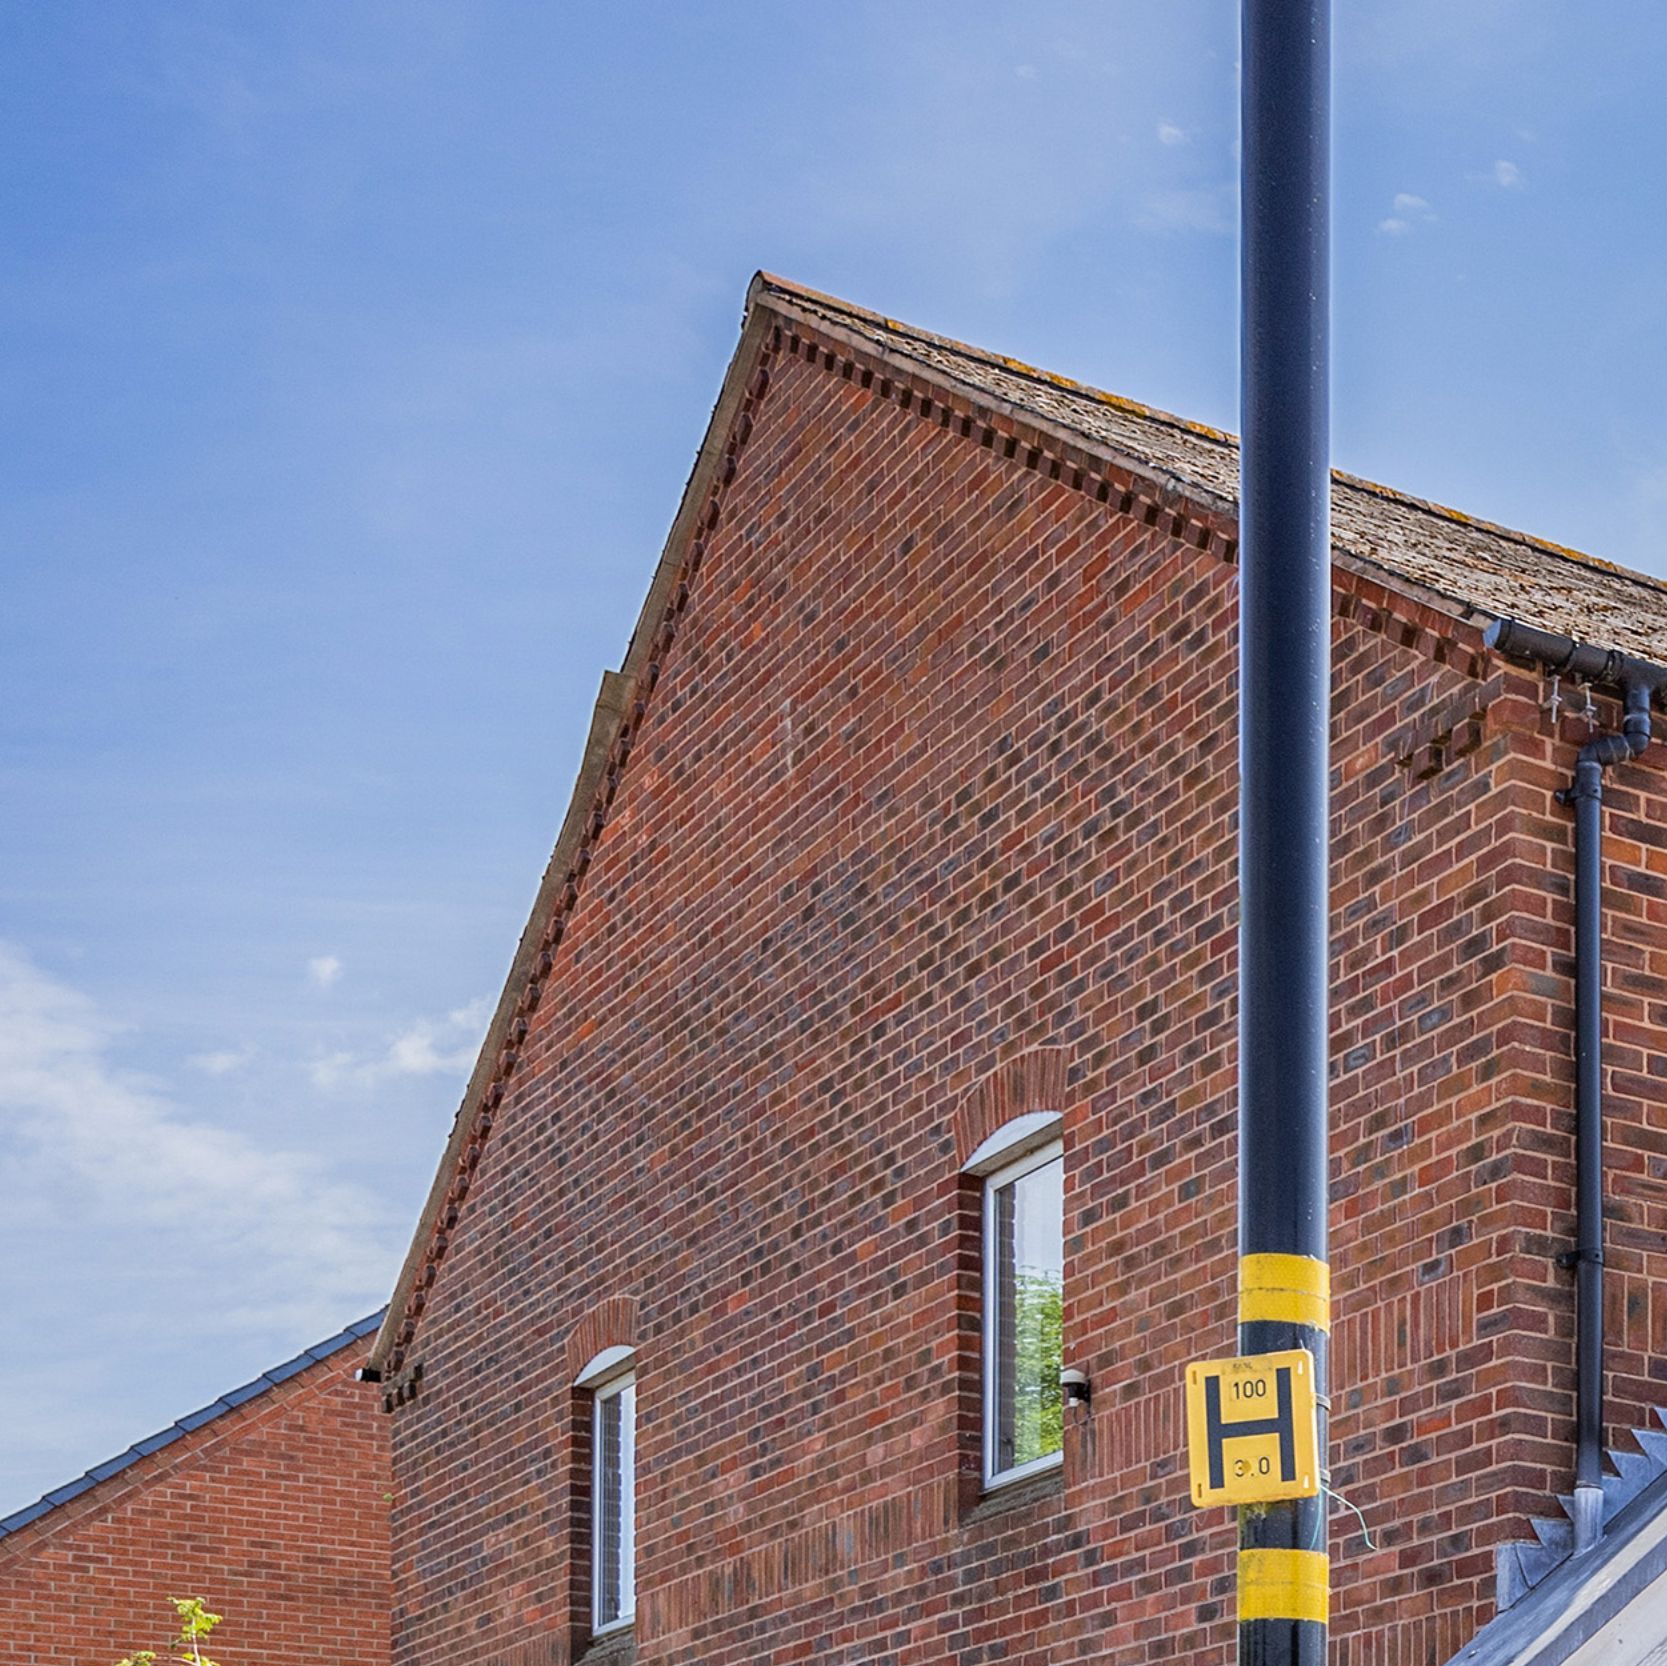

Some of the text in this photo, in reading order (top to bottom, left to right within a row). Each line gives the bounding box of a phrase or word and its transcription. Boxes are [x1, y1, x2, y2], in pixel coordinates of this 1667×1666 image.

[1233, 1379, 1267, 1399] 100
[1205, 1367, 1296, 1489] H
[1234, 1456, 1271, 1477] 3.0
